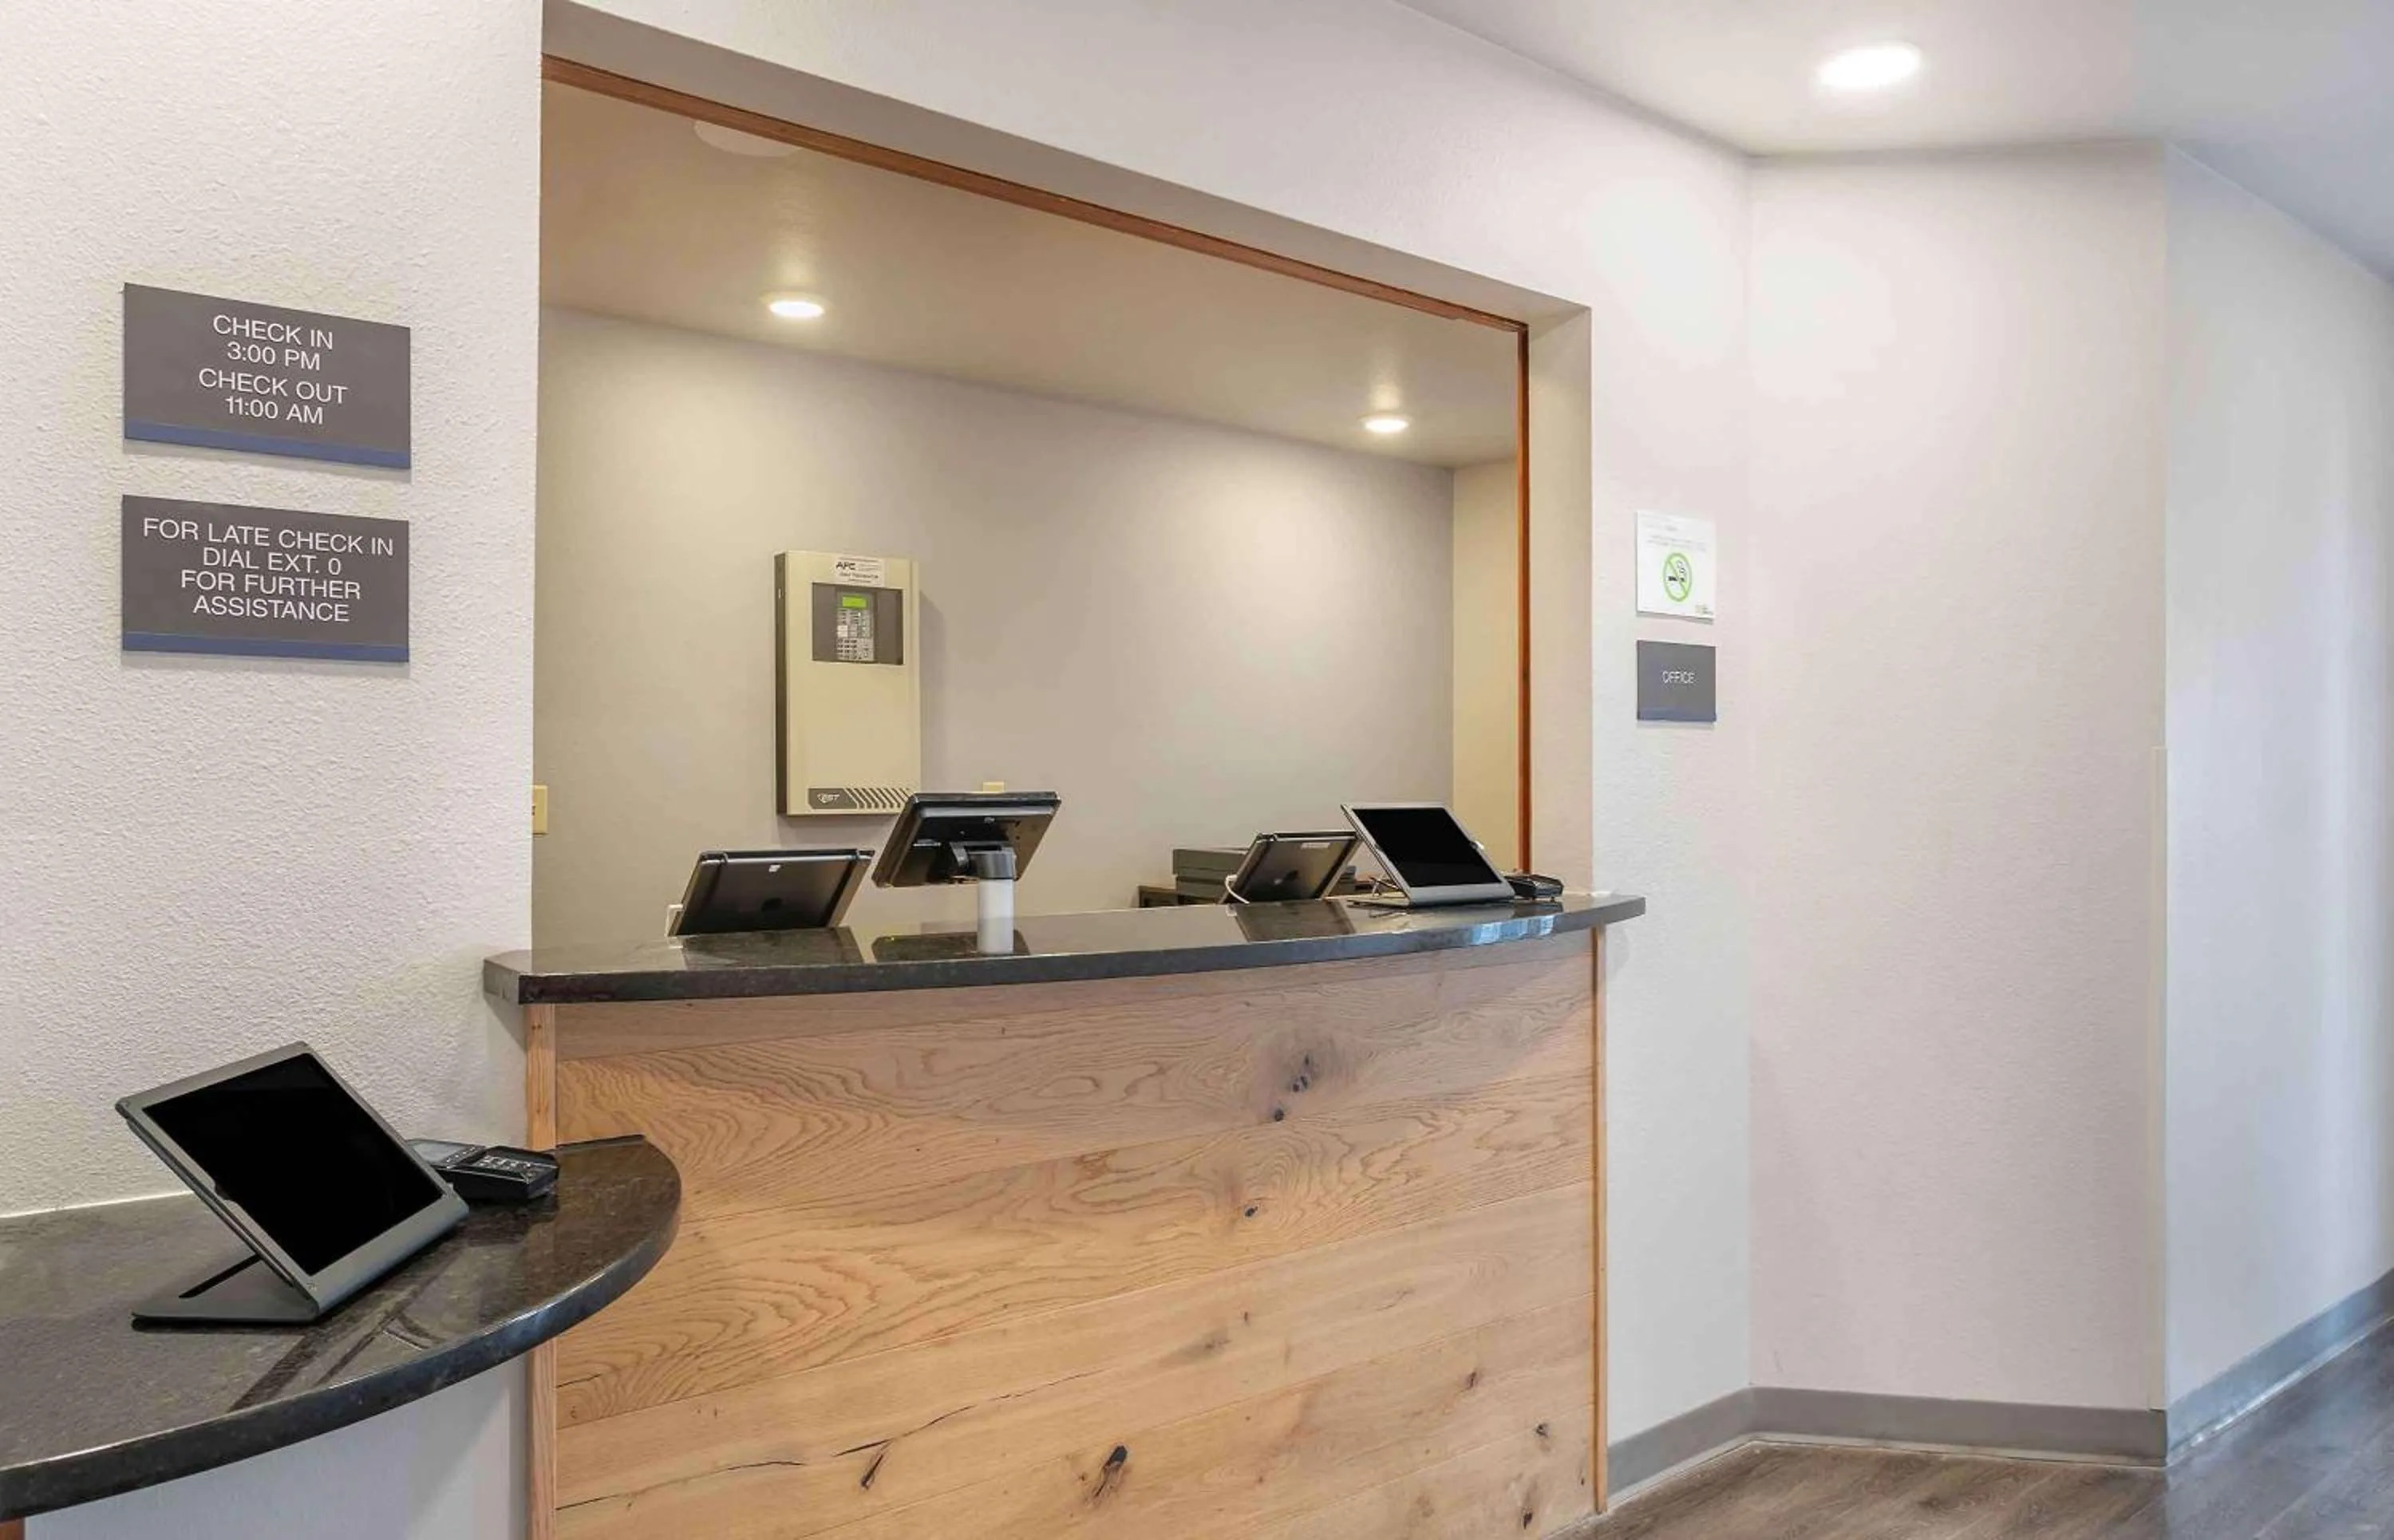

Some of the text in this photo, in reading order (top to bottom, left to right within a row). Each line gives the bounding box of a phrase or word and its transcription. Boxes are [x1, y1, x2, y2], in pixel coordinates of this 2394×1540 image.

[212, 314, 333, 350] CHECK IN
[227, 341, 320, 371] 3:00 PM
[199, 368, 349, 404] CHECK OUT
[225, 395, 323, 425] 11:00 AM
[143, 517, 393, 556] FOR LATE CHECK IN
[203, 547, 342, 575] DIAL EXT. 0
[181, 569, 361, 600] FOR FURTHER
[192, 594, 350, 622] ASSISTANCE
[1662, 669, 1695, 684] OFFICE
